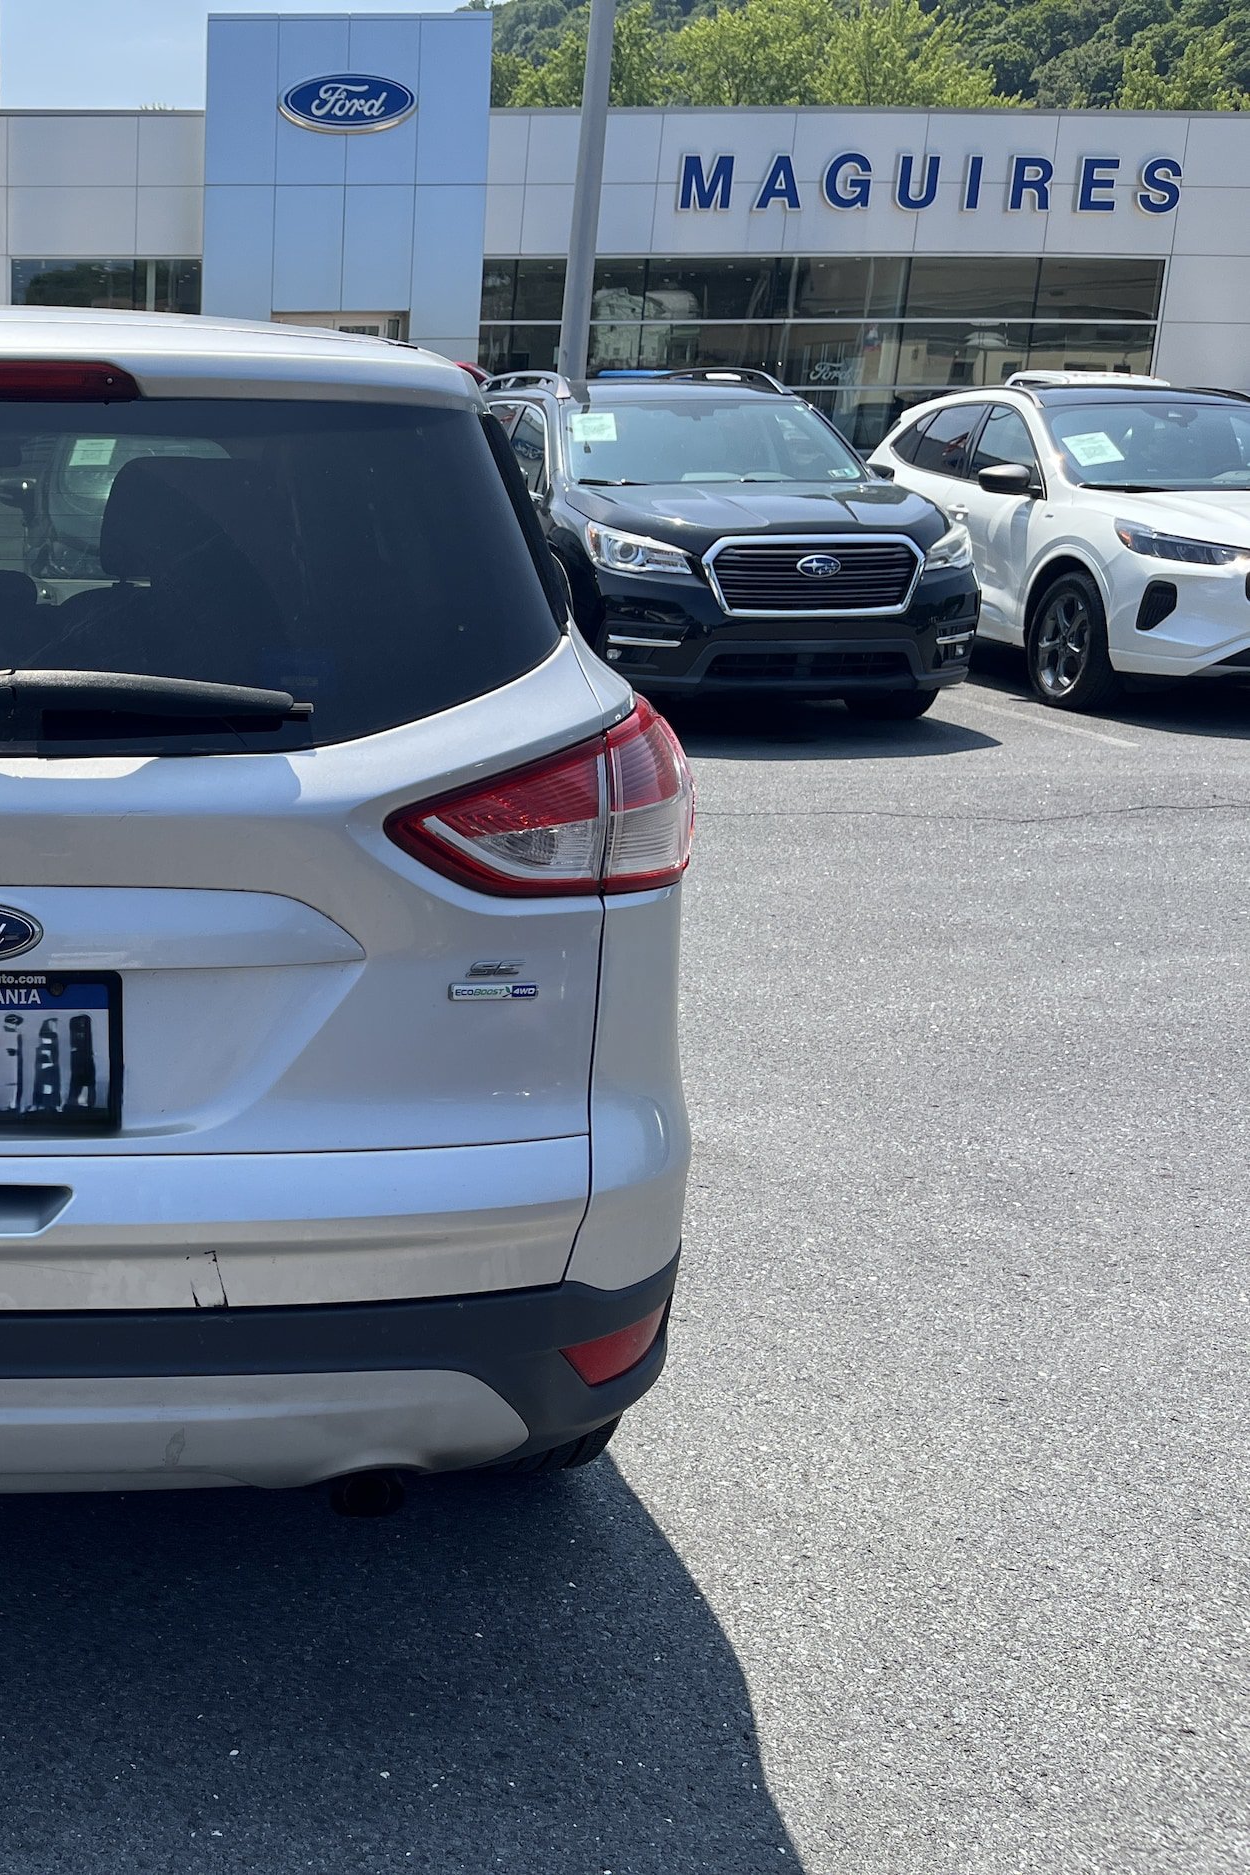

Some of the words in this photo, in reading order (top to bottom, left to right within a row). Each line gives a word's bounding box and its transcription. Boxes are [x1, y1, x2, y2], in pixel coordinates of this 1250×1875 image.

[311, 83, 387, 116] Ford
[678, 153, 1182, 214] MAGUIRES
[810, 362, 854, 380] Ford
[465, 960, 527, 978] SE
[513, 987, 535, 995] 4WD
